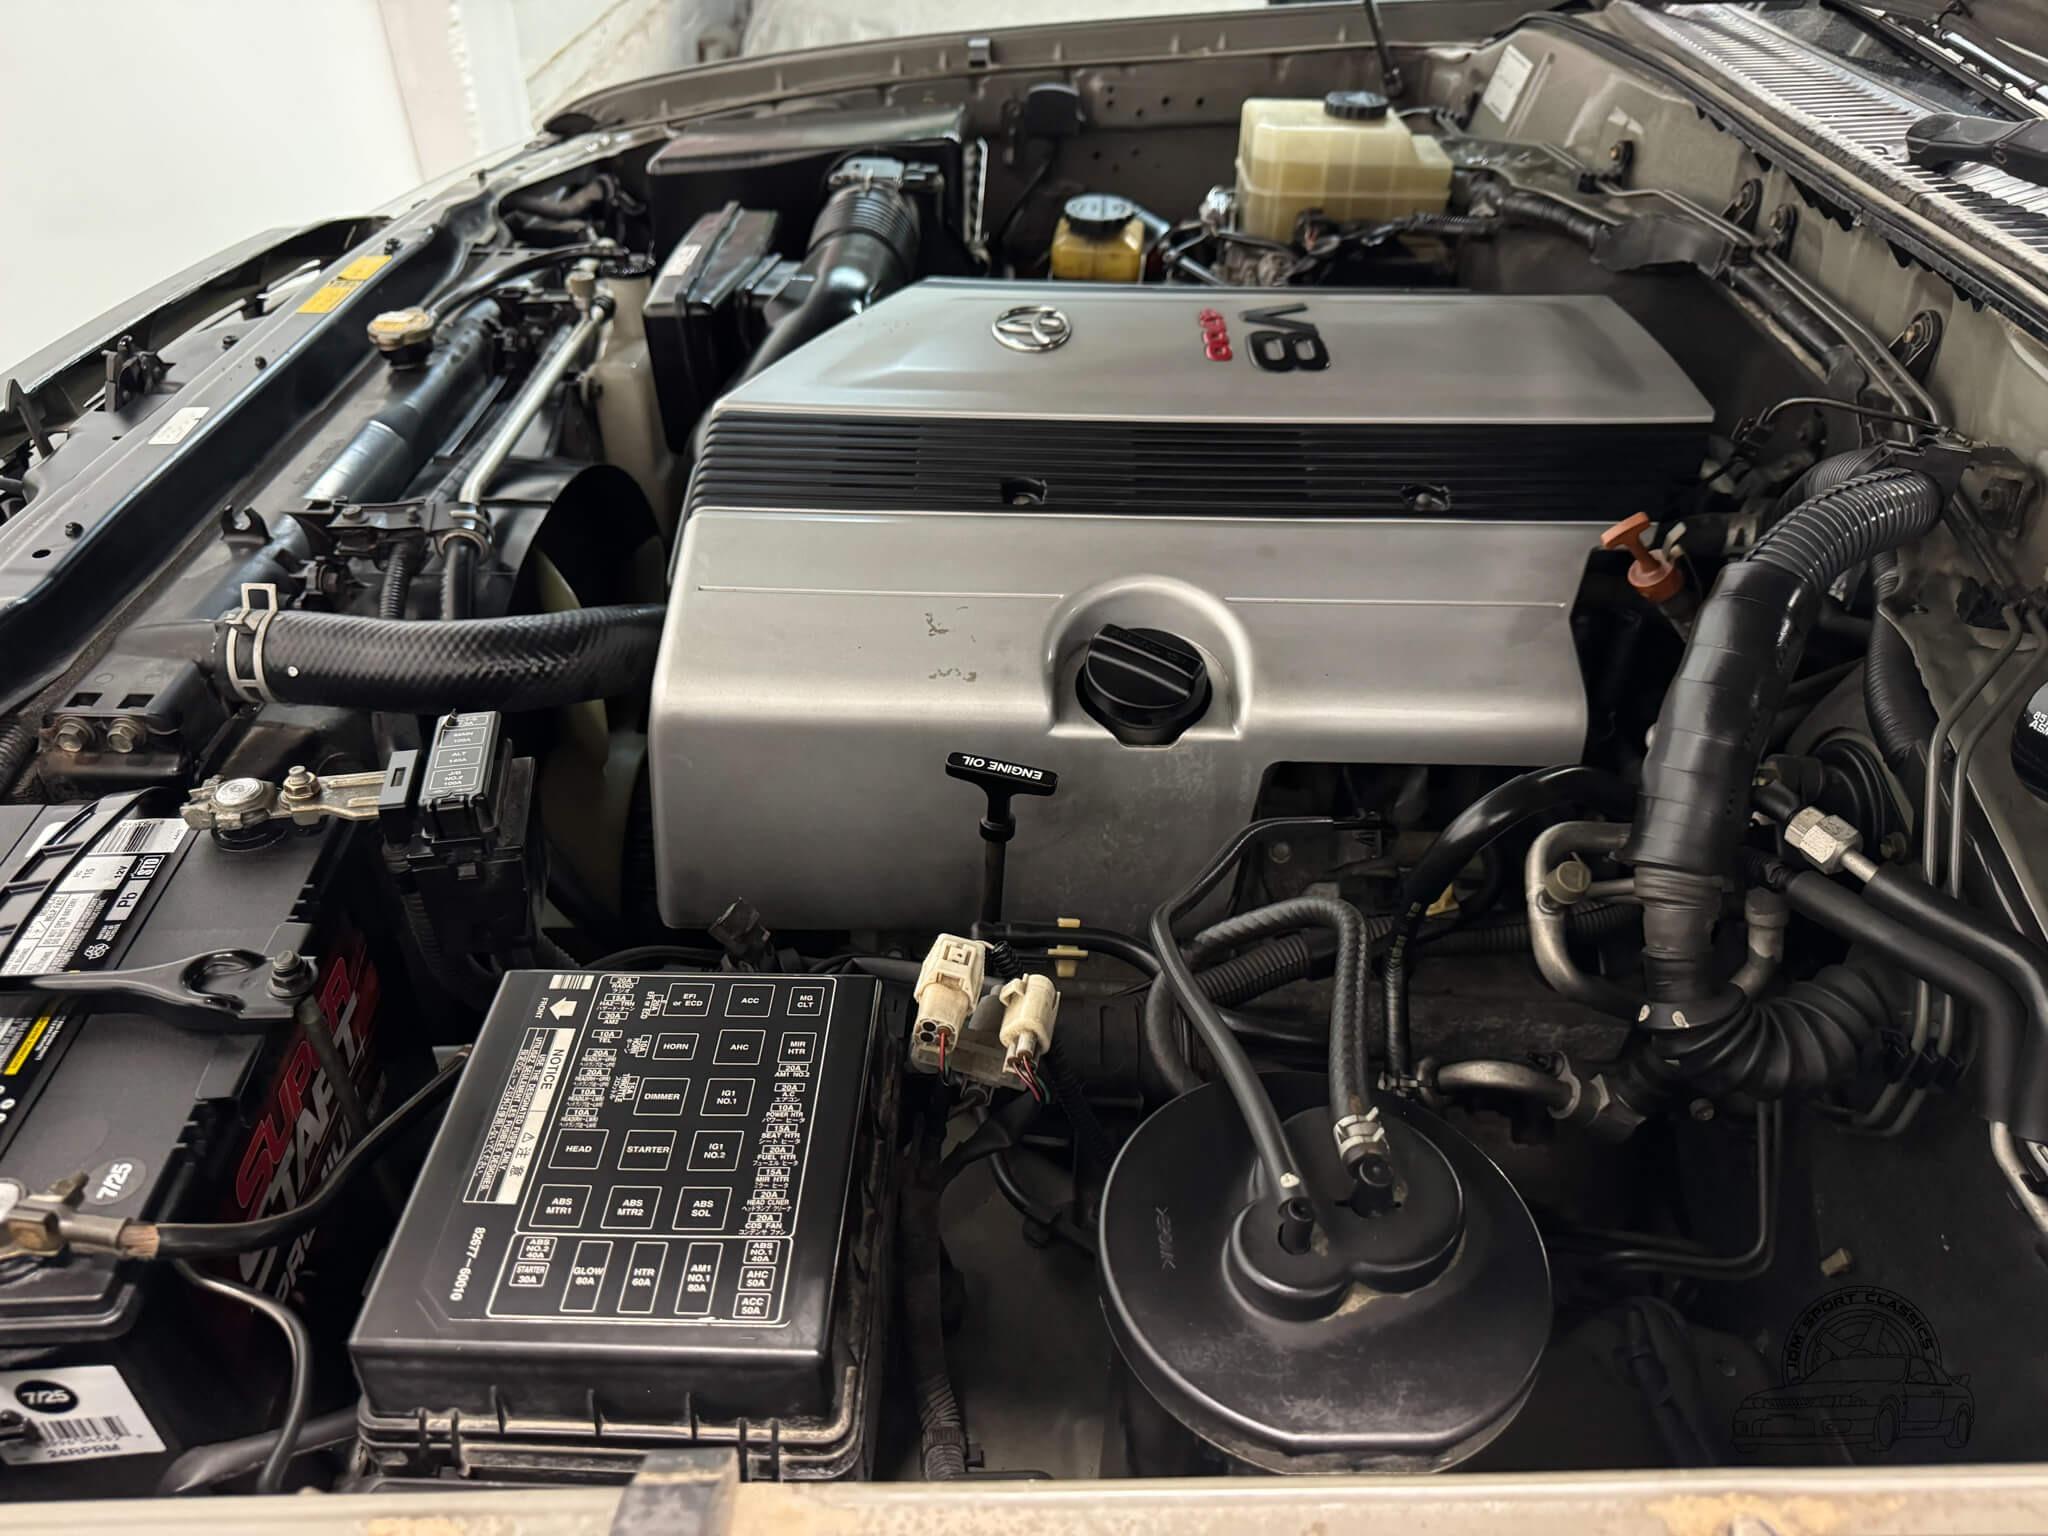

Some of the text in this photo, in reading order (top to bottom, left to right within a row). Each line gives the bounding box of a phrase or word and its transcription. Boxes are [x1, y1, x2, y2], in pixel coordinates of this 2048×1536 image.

[1238, 302, 1330, 373] V8
[962, 755, 1043, 780] ENGINE OIL
[137, 858, 160, 876] STD
[114, 866, 127, 879] 12V
[116, 892, 138, 908] Pb
[535, 997, 549, 1019] FRONT
[535, 1054, 546, 1067] USE
[541, 1048, 565, 1090] NOTICE
[530, 1069, 540, 1080] THE
[643, 1093, 681, 1101] DIMMER
[716, 1097, 738, 1105] NO.1
[505, 1126, 520, 1149] FUSES
[565, 1145, 593, 1153] HEAD
[703, 1151, 727, 1159] NO.2
[96, 1163, 133, 1199] 7/25
[622, 1199, 643, 1207] ABS
[693, 1200, 714, 1208] ABS
[545, 1207, 572, 1215] MTR1
[617, 1208, 645, 1217] MTR2
[691, 1209, 711, 1217] SOL
[756, 1214, 774, 1222] 20A
[516, 1266, 545, 1274] STARTER
[573, 1267, 605, 1276] GLOW
[633, 1268, 655, 1276] HTR
[690, 1264, 711, 1272] AM1
[687, 1274, 711, 1282] NO.1
[747, 1270, 769, 1278] AHC
[517, 1275, 538, 1284] 30A
[632, 1278, 651, 1287] 60A
[747, 1279, 766, 1287] 50A
[687, 1284, 707, 1292] 80A
[741, 1297, 764, 1306] ACC
[741, 1306, 760, 1315] 50A
[21, 1388, 71, 1405] 7/25
